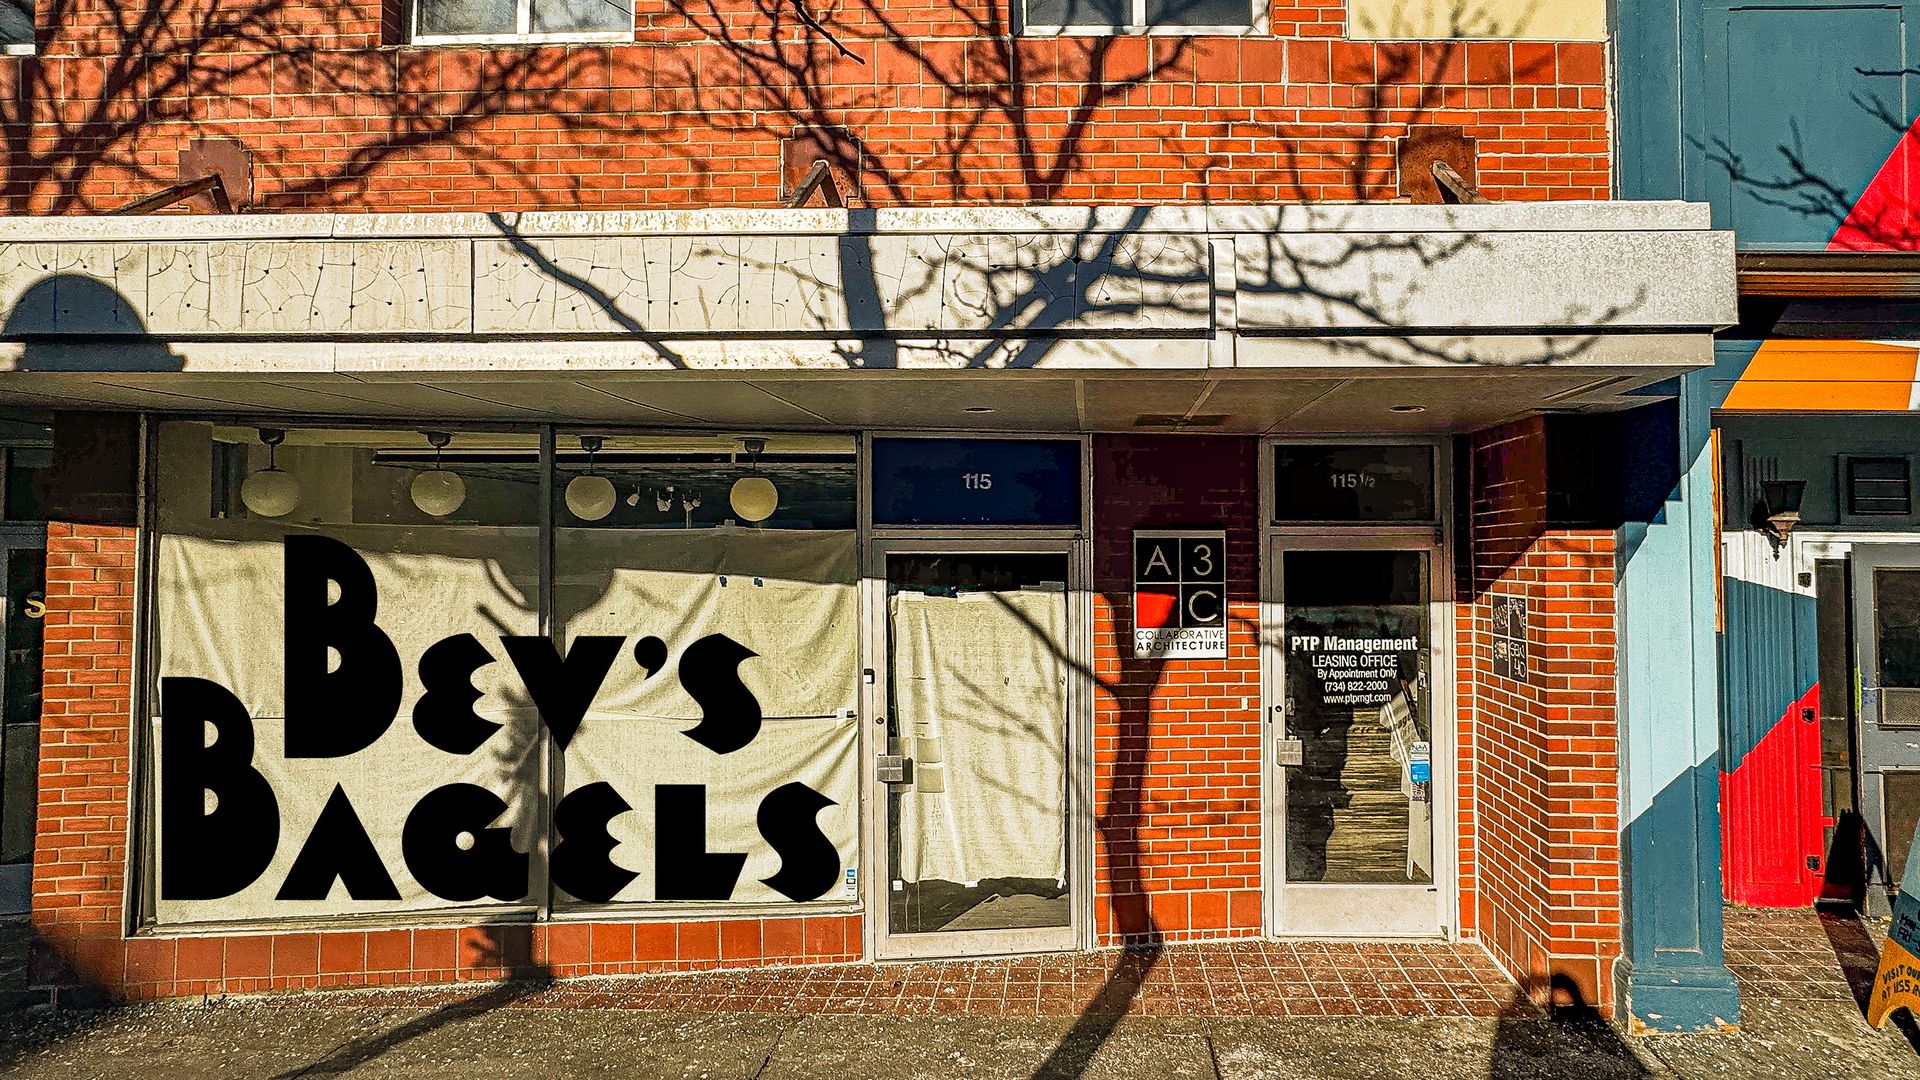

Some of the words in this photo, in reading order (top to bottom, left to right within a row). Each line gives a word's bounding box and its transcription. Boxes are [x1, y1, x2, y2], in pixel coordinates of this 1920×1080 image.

[962, 473, 992, 489] 115
[1136, 630, 1225, 640] COLLABORATIVE
[1136, 641, 1225, 651] ARCHITECTURE
[1291, 636, 1320, 651] PTP
[1323, 636, 1418, 653] Management
[1312, 655, 1357, 667] LEASING
[1360, 655, 1398, 667] OFFICE
[1317, 669, 1328, 680] By
[1328, 668, 1378, 680] Appointment
[1380, 668, 1398, 679] Only
[1325, 681, 1346, 693] (734)
[1347, 680, 1388, 691] 822-2000
[1323, 692, 1392, 705] www.ptpmgt.com
[161, 677, 841, 902] BAGELS
[1882, 964, 1905, 985] VISIT
